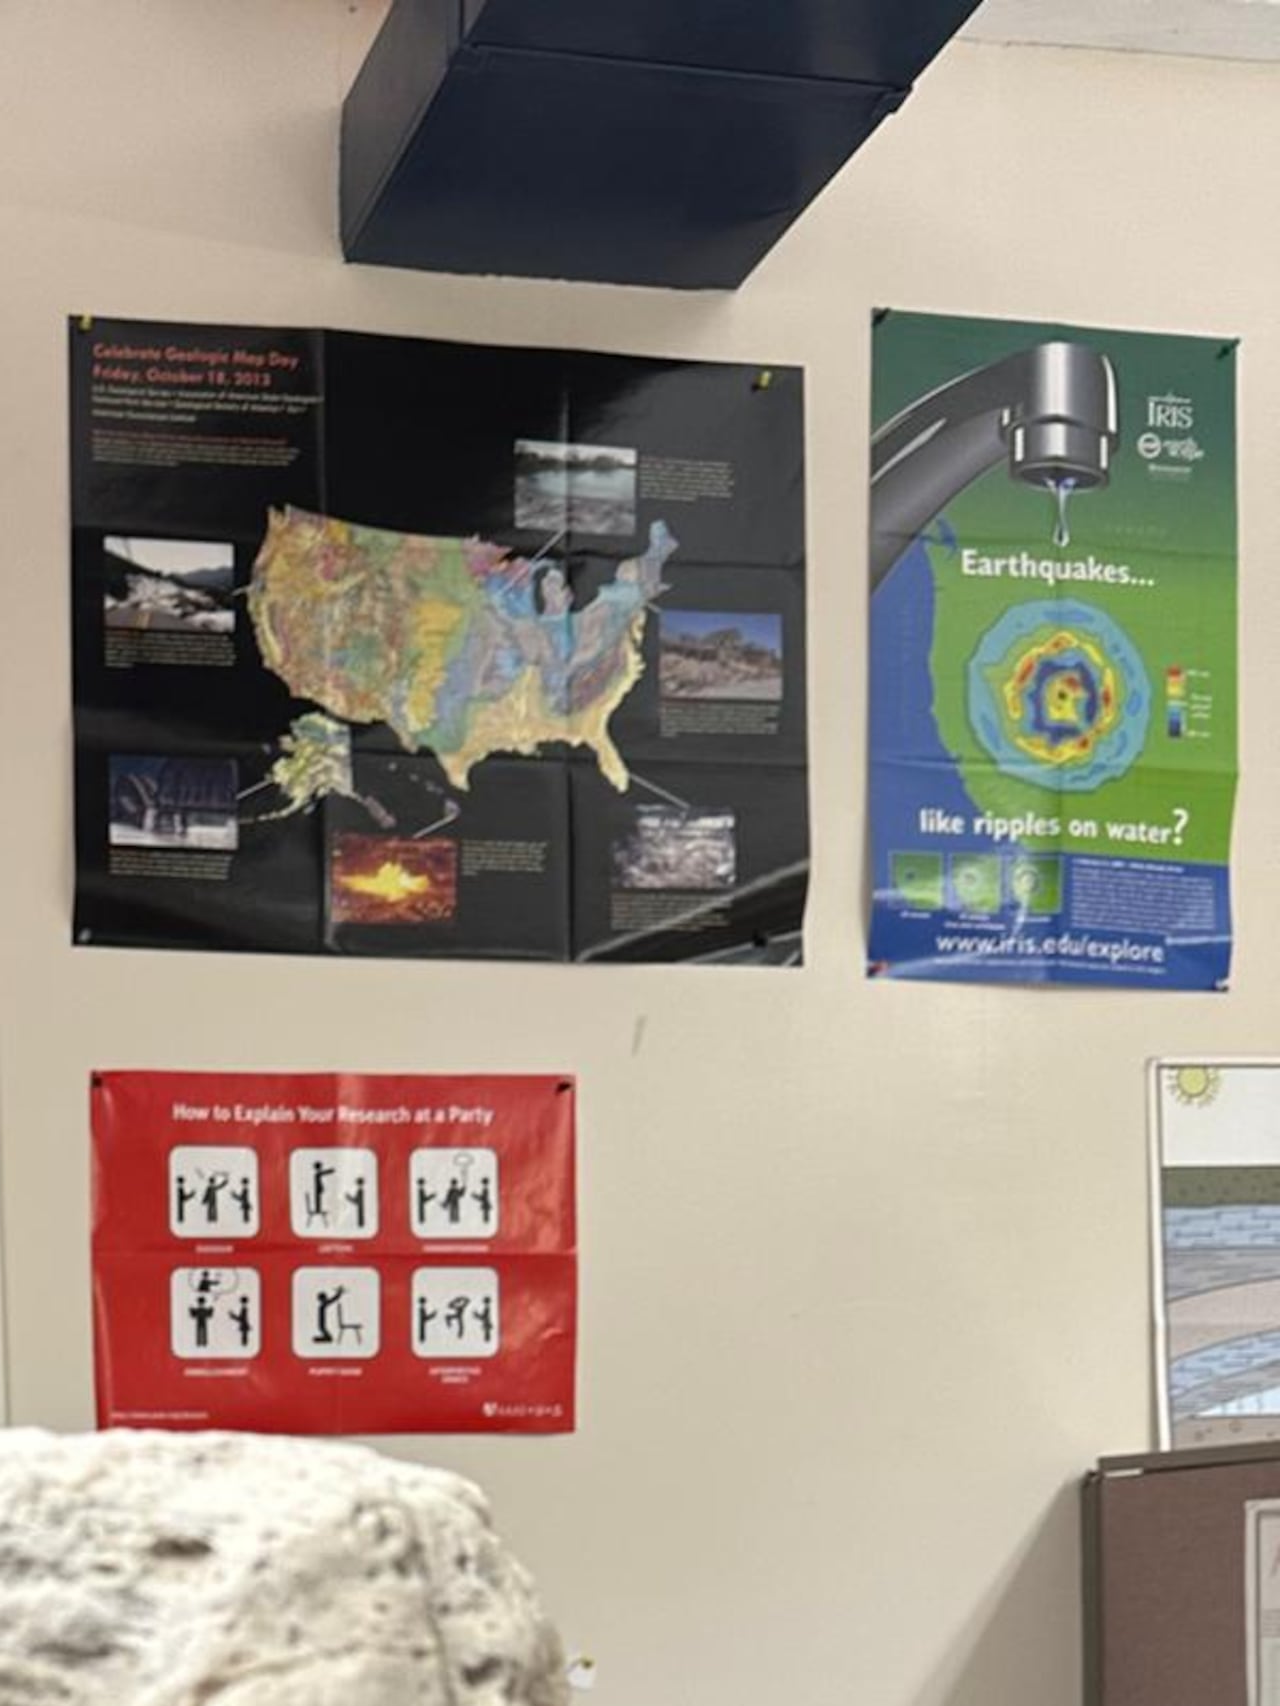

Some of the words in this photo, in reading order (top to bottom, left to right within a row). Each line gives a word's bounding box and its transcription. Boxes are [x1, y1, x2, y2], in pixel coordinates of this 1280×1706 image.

[92, 344, 161, 360] Celebrate
[166, 347, 230, 367] Geologic
[233, 351, 266, 369] Map
[269, 352, 299, 370] Day
[147, 368, 204, 384] October
[1147, 400, 1194, 429] IRIS
[961, 548, 1155, 587] Earthquakes...
[919, 808, 965, 835] like
[973, 812, 1061, 842] ripples
[1068, 820, 1097, 838] on
[1106, 808, 1189, 846] water?
[936, 933, 1166, 964] www.iris.edu/explore
[172, 1104, 209, 1121] How
[212, 1105, 231, 1121] to
[234, 1104, 295, 1126] Explain
[296, 1106, 334, 1122] Your
[338, 1105, 411, 1124] Research
[414, 1107, 430, 1123] at
[434, 1109, 445, 1123] a
[449, 1106, 495, 1126] Party
